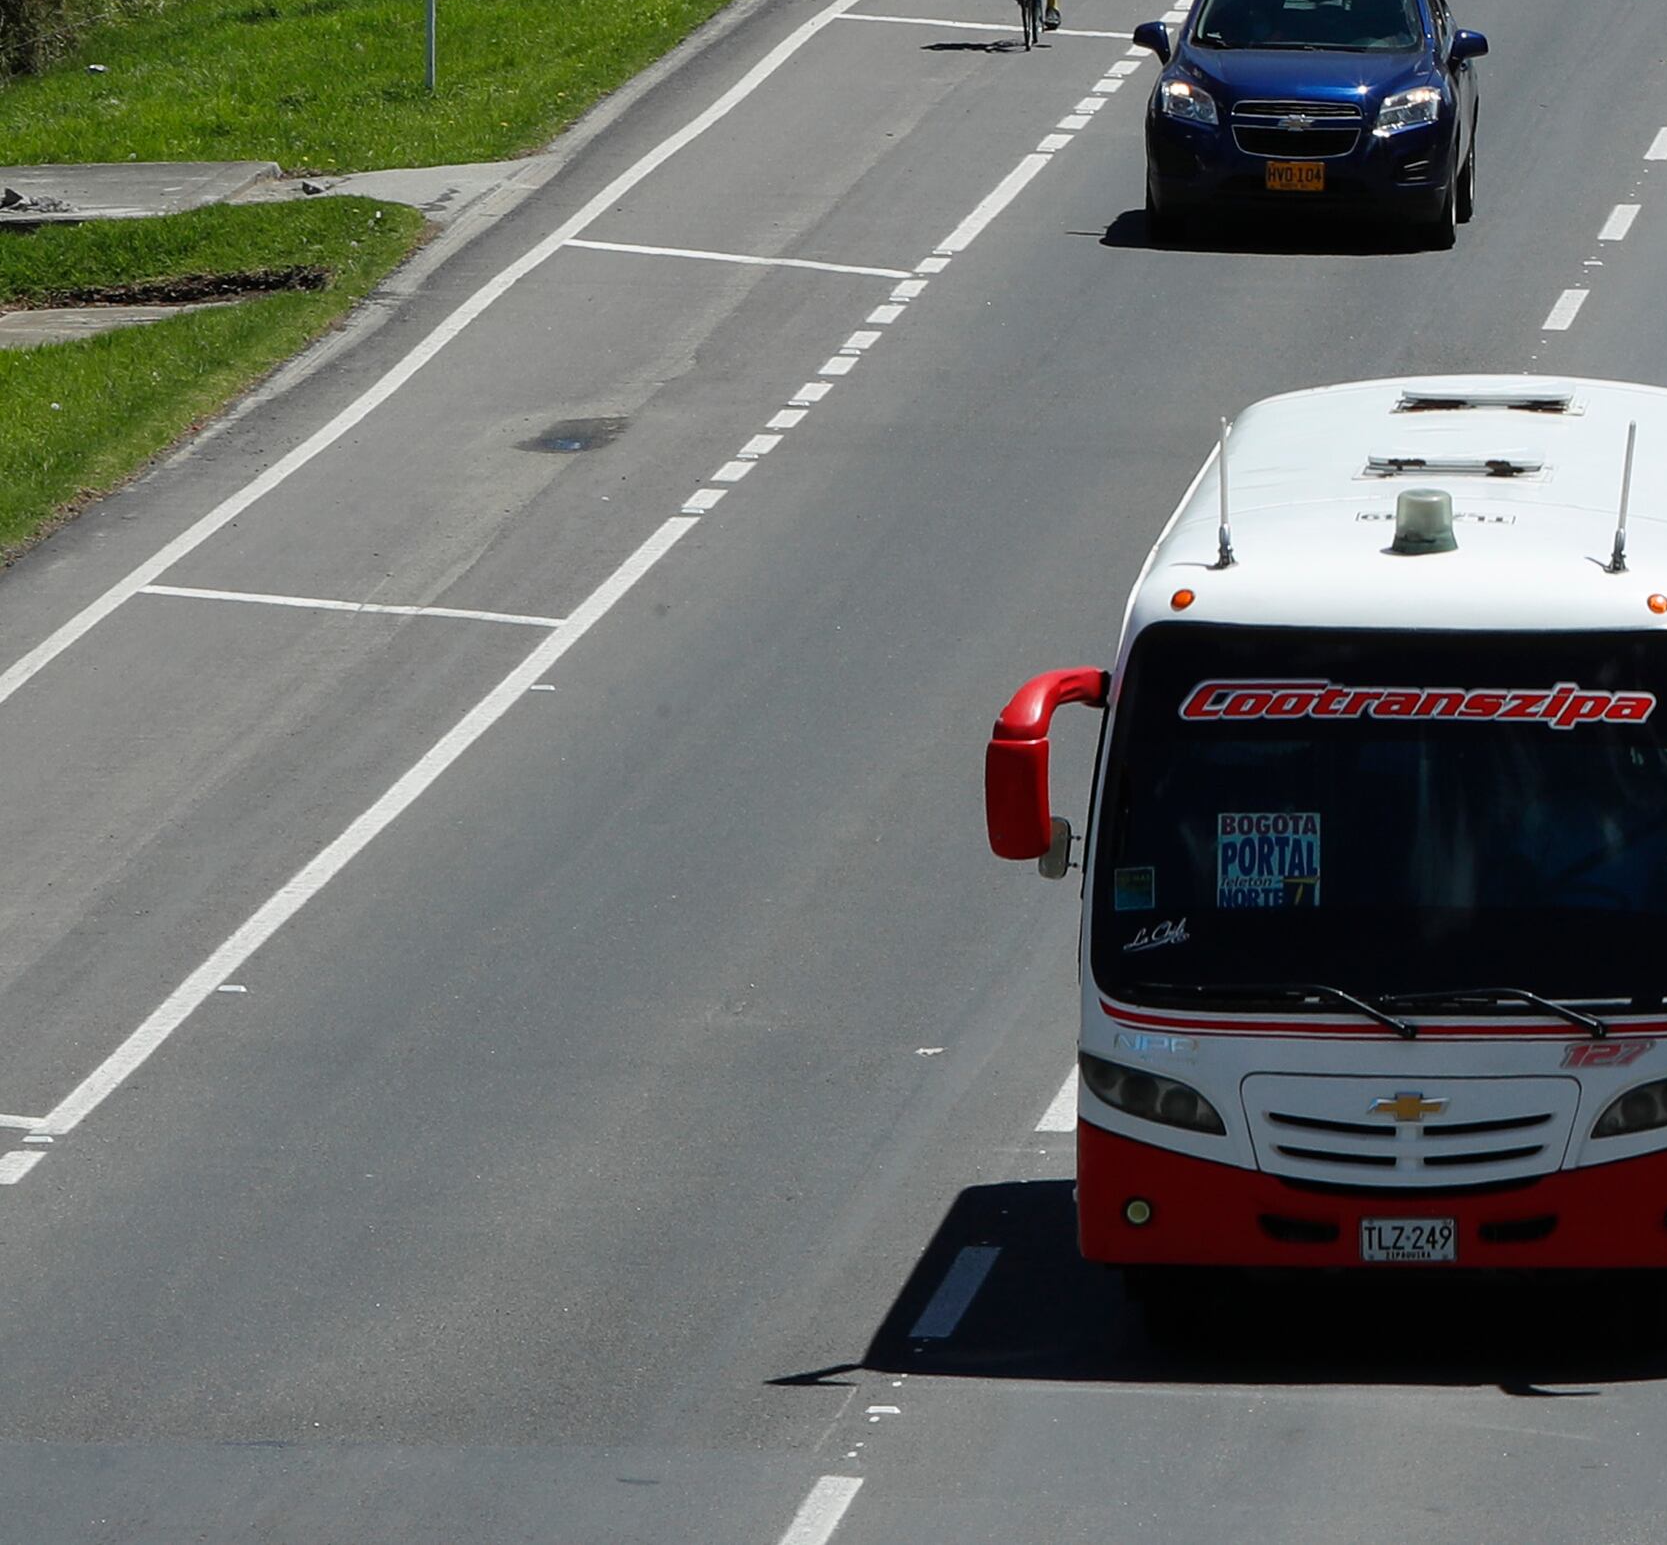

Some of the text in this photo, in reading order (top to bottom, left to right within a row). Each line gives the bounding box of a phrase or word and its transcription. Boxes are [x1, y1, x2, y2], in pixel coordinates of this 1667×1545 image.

[1183, 679, 1656, 730] Cootranszipa
[1221, 815, 1317, 835] BOGOTA
[1222, 837, 1318, 876] PORTAL
[1219, 888, 1285, 907] NORTE
[1560, 1039, 1656, 1068] 127
